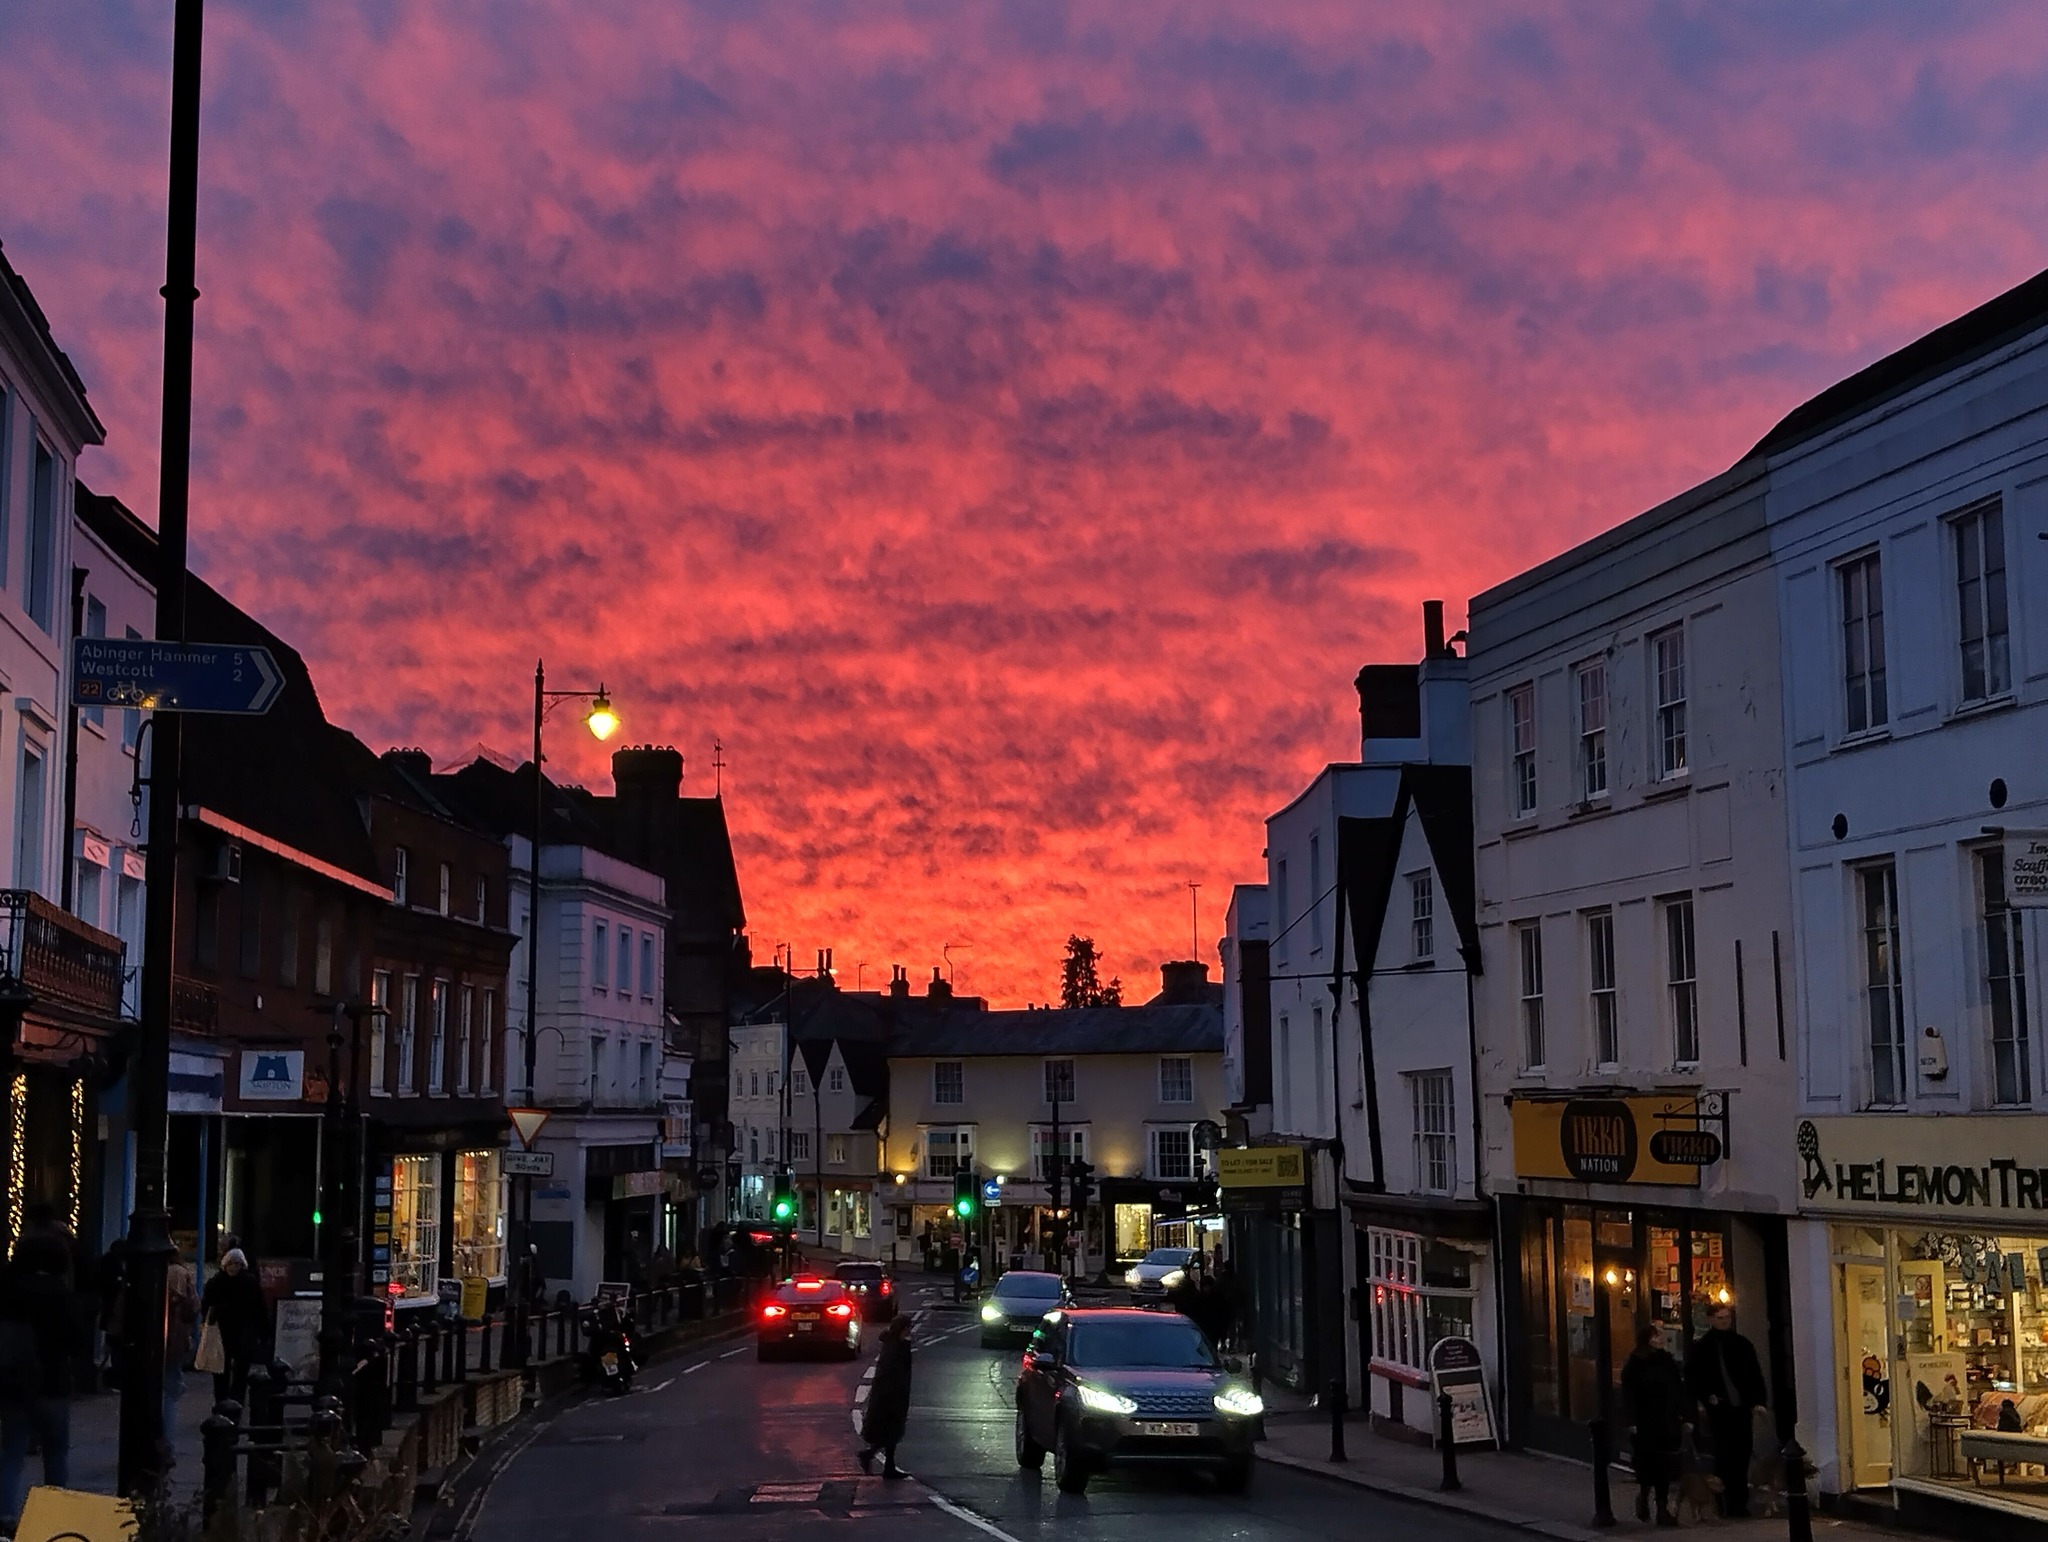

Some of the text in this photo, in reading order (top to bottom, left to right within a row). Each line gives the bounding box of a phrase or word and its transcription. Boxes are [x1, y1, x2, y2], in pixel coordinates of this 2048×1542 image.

[81, 645, 243, 666] Abinger Hammer 5
[81, 661, 243, 682] Westcott 2
[82, 683, 99, 696] 22
[2013, 858, 2048, 874] Scaff
[1580, 1157, 1619, 1173] NATION
[1668, 1154, 1707, 1163] NATION
